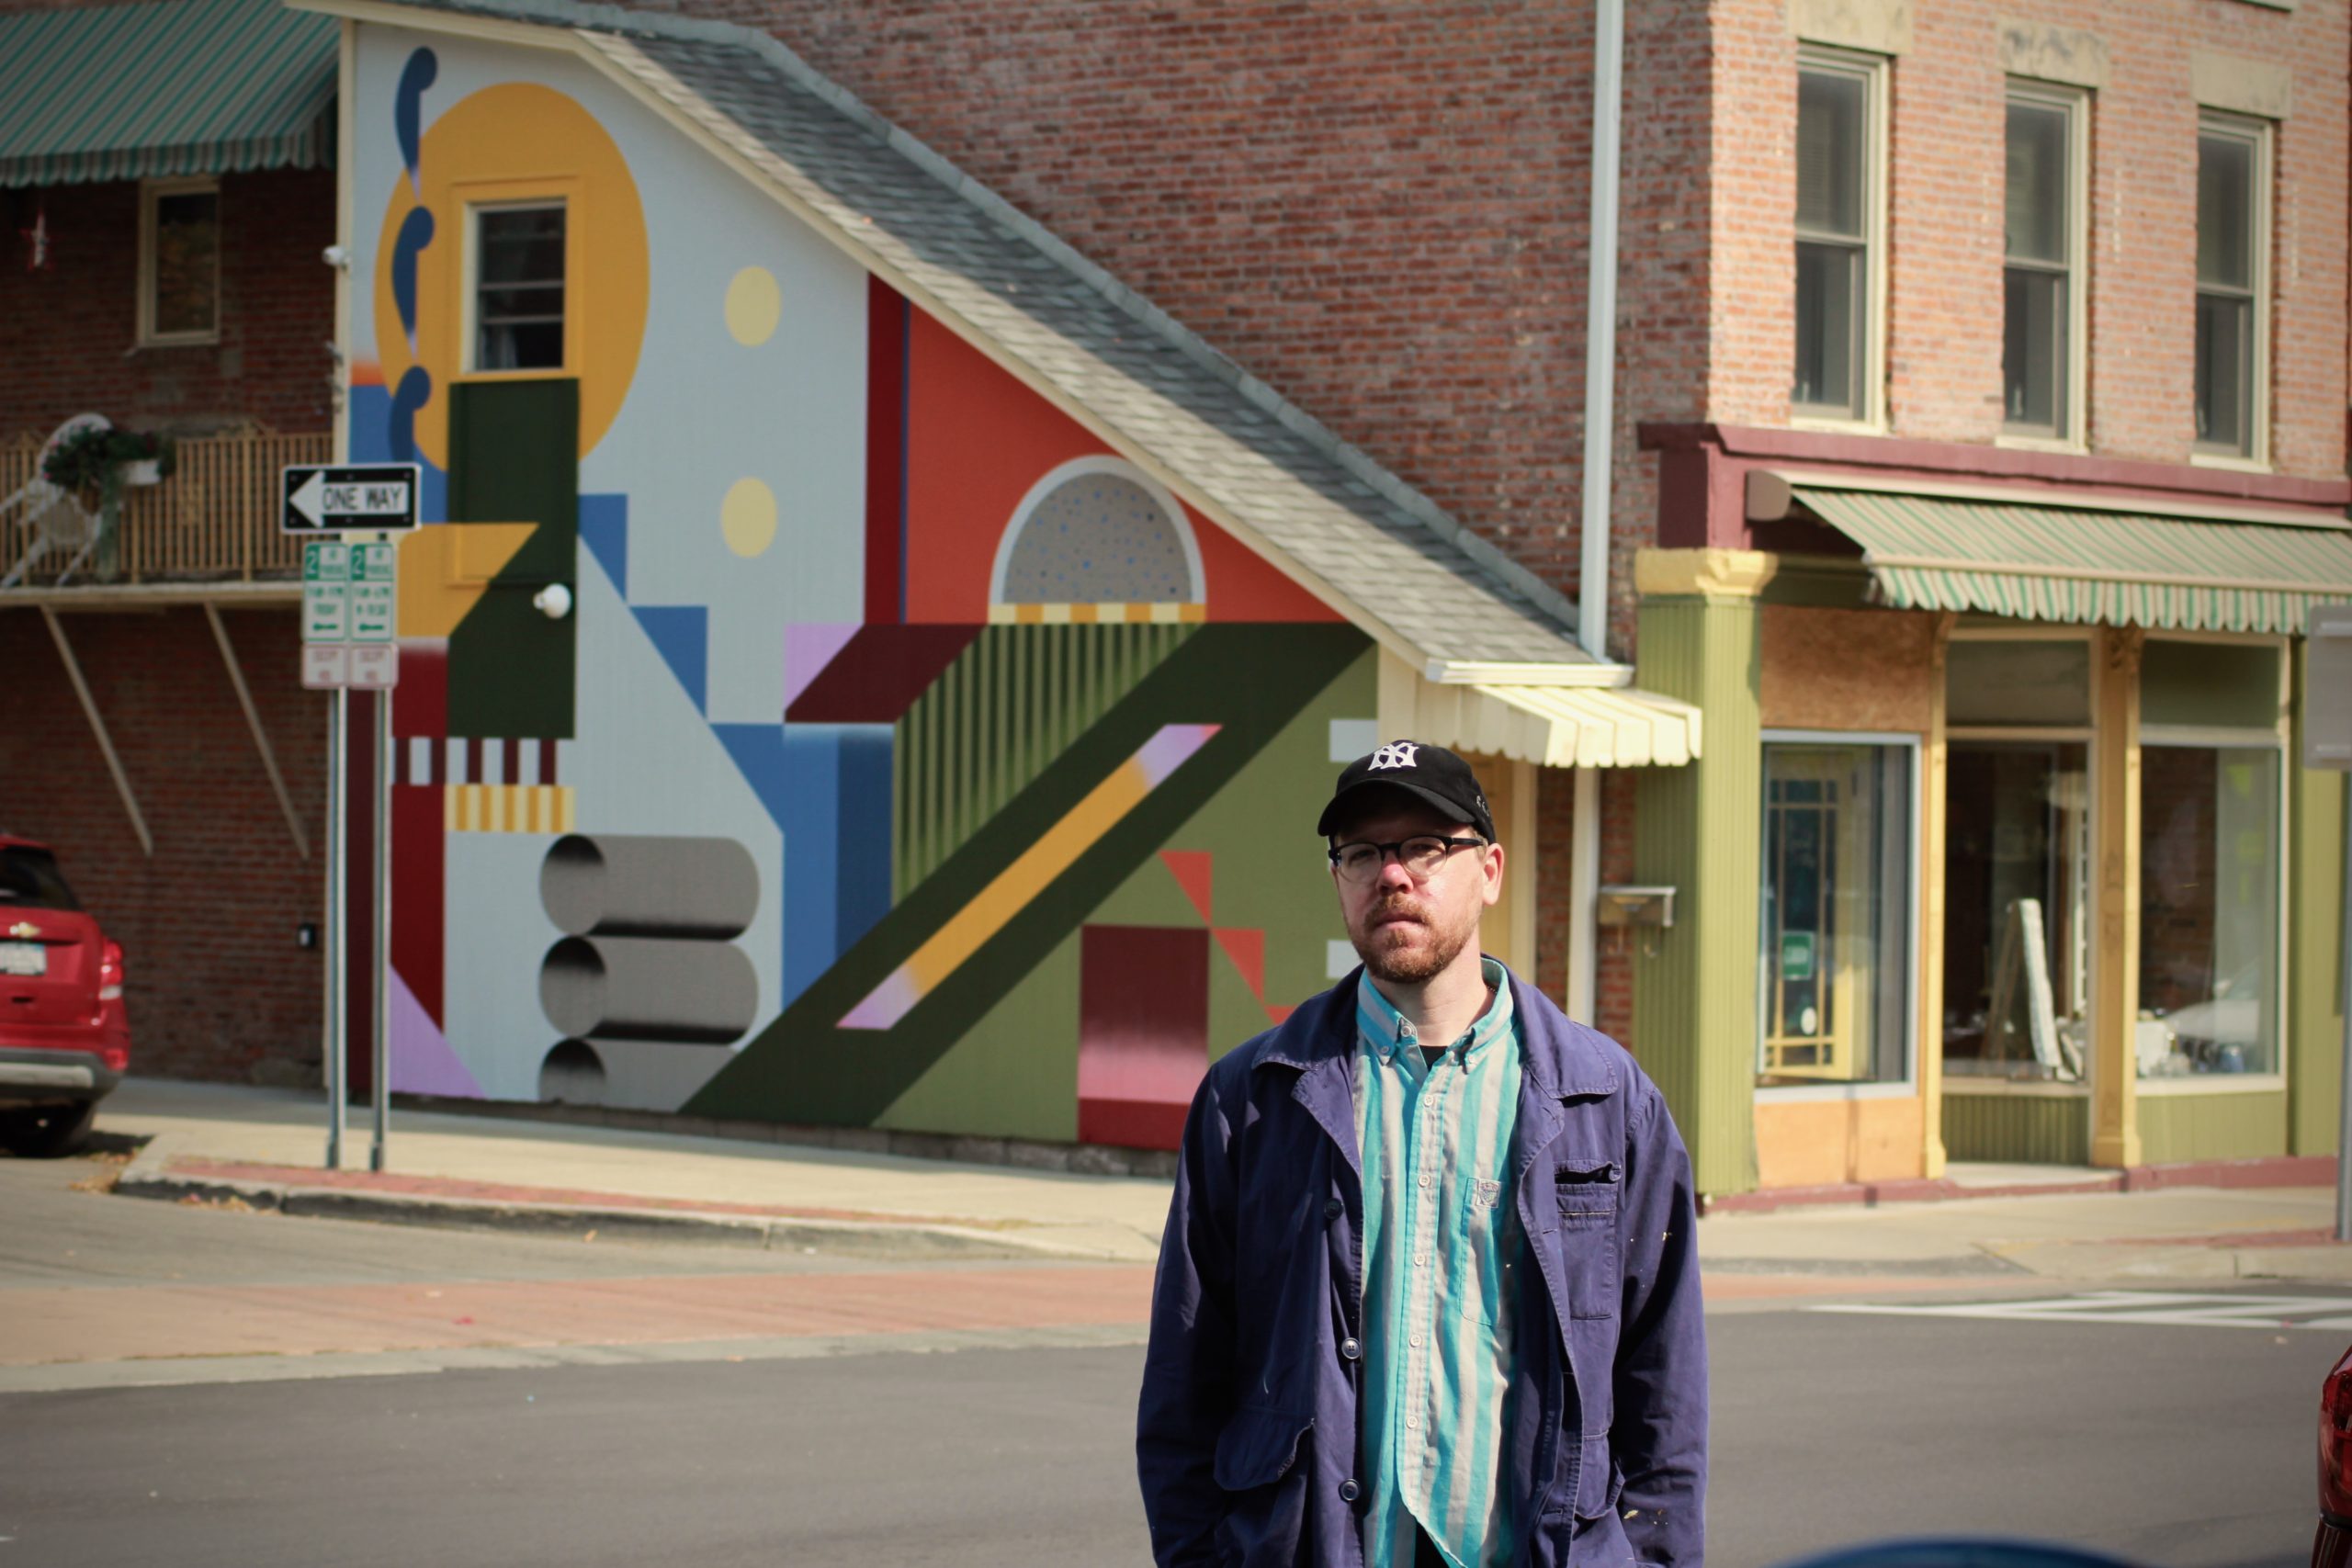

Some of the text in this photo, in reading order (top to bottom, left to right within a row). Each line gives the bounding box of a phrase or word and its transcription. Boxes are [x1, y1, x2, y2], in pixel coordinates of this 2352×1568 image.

[322, 485, 402, 511] ONE WAY
[307, 550, 318, 575] 2
[353, 550, 364, 575] 2
